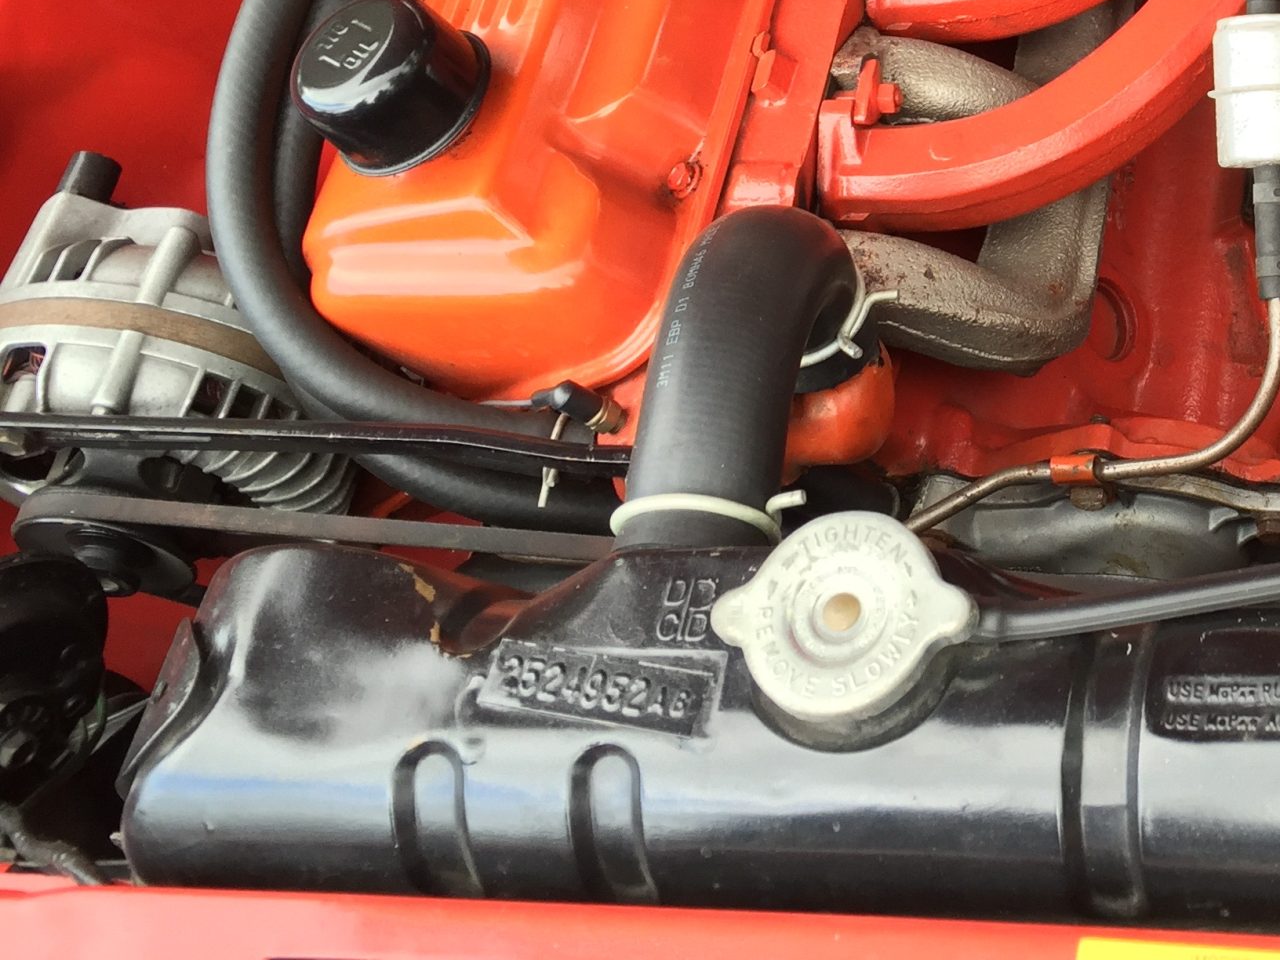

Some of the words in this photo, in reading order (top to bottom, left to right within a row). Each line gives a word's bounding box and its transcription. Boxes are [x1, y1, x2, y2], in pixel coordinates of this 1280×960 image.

[343, 41, 379, 70] OIL
[665, 319, 683, 347] EBP
[797, 523, 909, 566] TIGHTEN
[830, 610, 921, 698] SLOWLY
[1166, 681, 1203, 702] USE
[1163, 713, 1200, 732] USE
